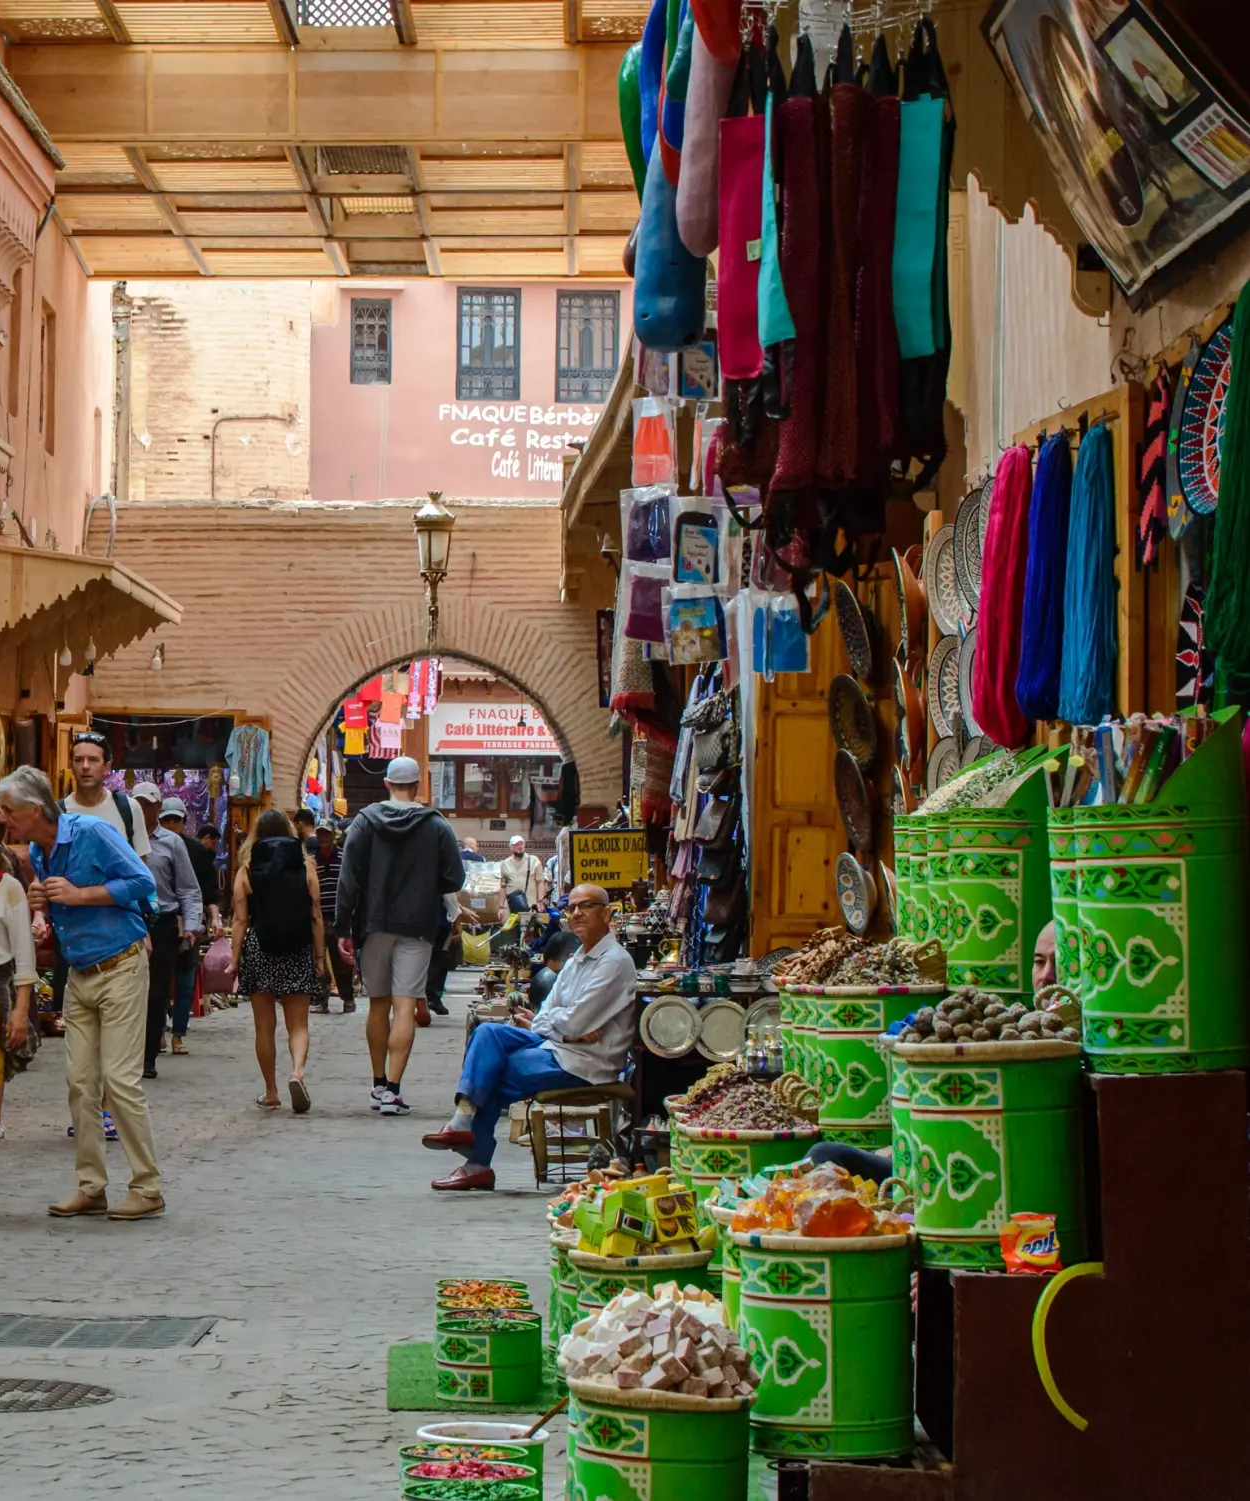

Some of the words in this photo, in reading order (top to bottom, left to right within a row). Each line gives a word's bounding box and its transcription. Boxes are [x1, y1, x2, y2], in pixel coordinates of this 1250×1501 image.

[439, 404, 527, 425] FNAQUE
[450, 428, 516, 447] Café
[526, 429, 588, 449] Rest
[491, 451, 519, 479] Café
[469, 708, 527, 721] FNAQUE
[445, 723, 473, 736] Café
[476, 723, 534, 736] Littéraire
[578, 838, 590, 852] LA
[591, 838, 620, 853] CROIX
[623, 837, 647, 852] D'AG
[580, 858, 608, 867] OPEN
[581, 871, 621, 880] OUVERT
